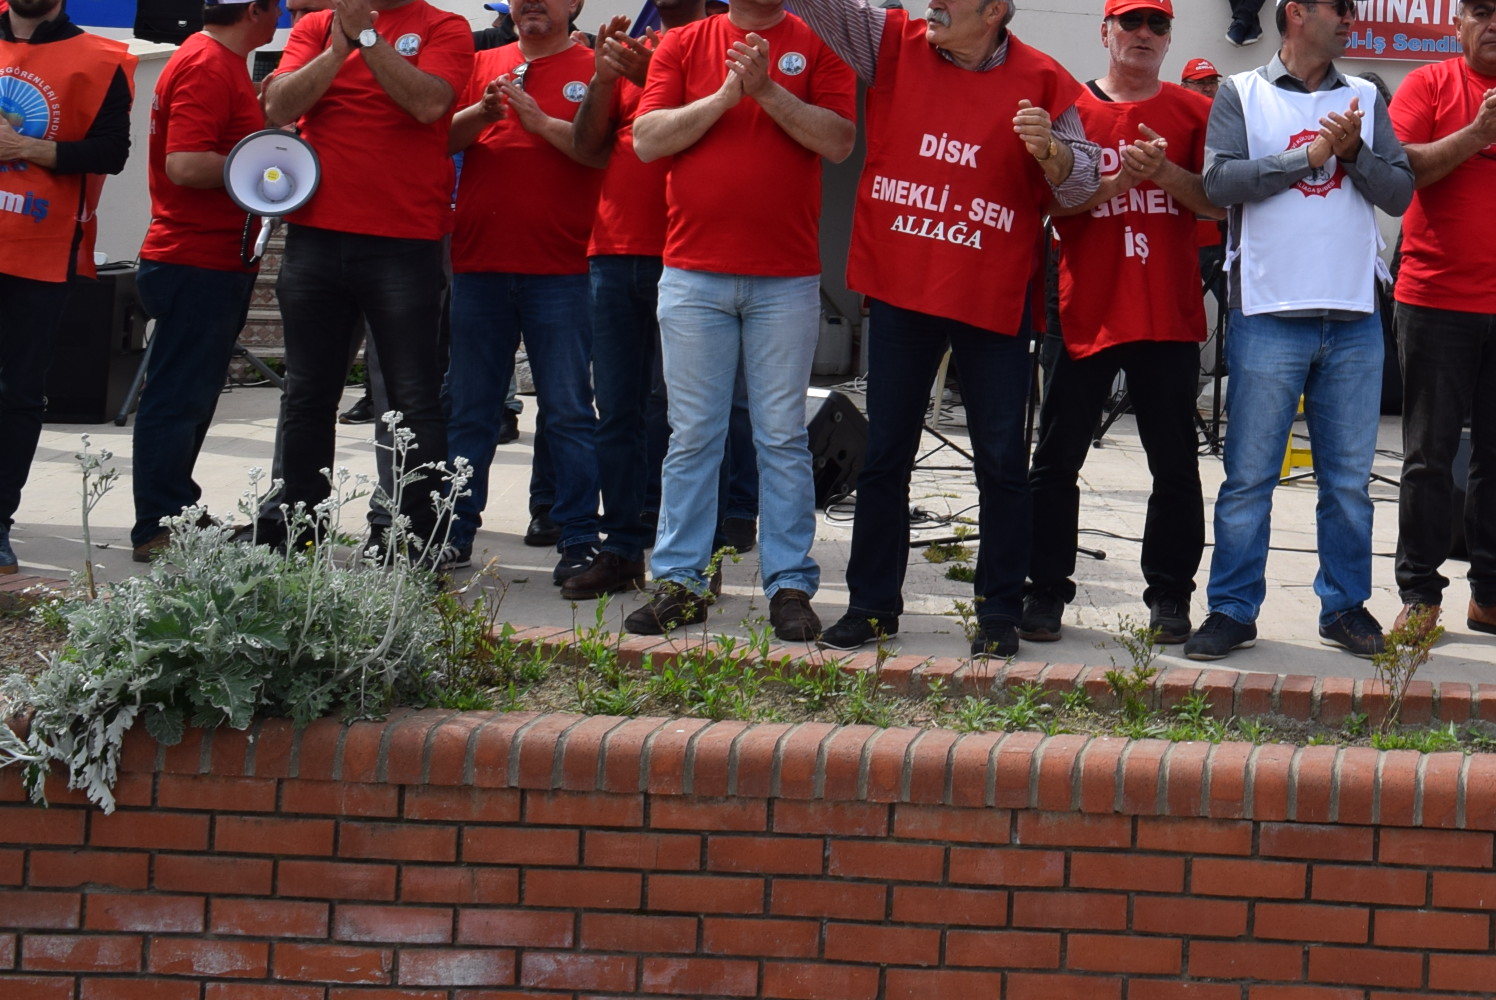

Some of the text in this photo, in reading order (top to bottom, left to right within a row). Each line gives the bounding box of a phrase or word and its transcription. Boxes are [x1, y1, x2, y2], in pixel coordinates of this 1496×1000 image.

[919, 131, 982, 169] DİSK
[872, 174, 950, 213] EMEKLİ
[968, 197, 1015, 233] SEN
[1090, 188, 1180, 219] GENEL
[1124, 225, 1150, 265] İŞ
